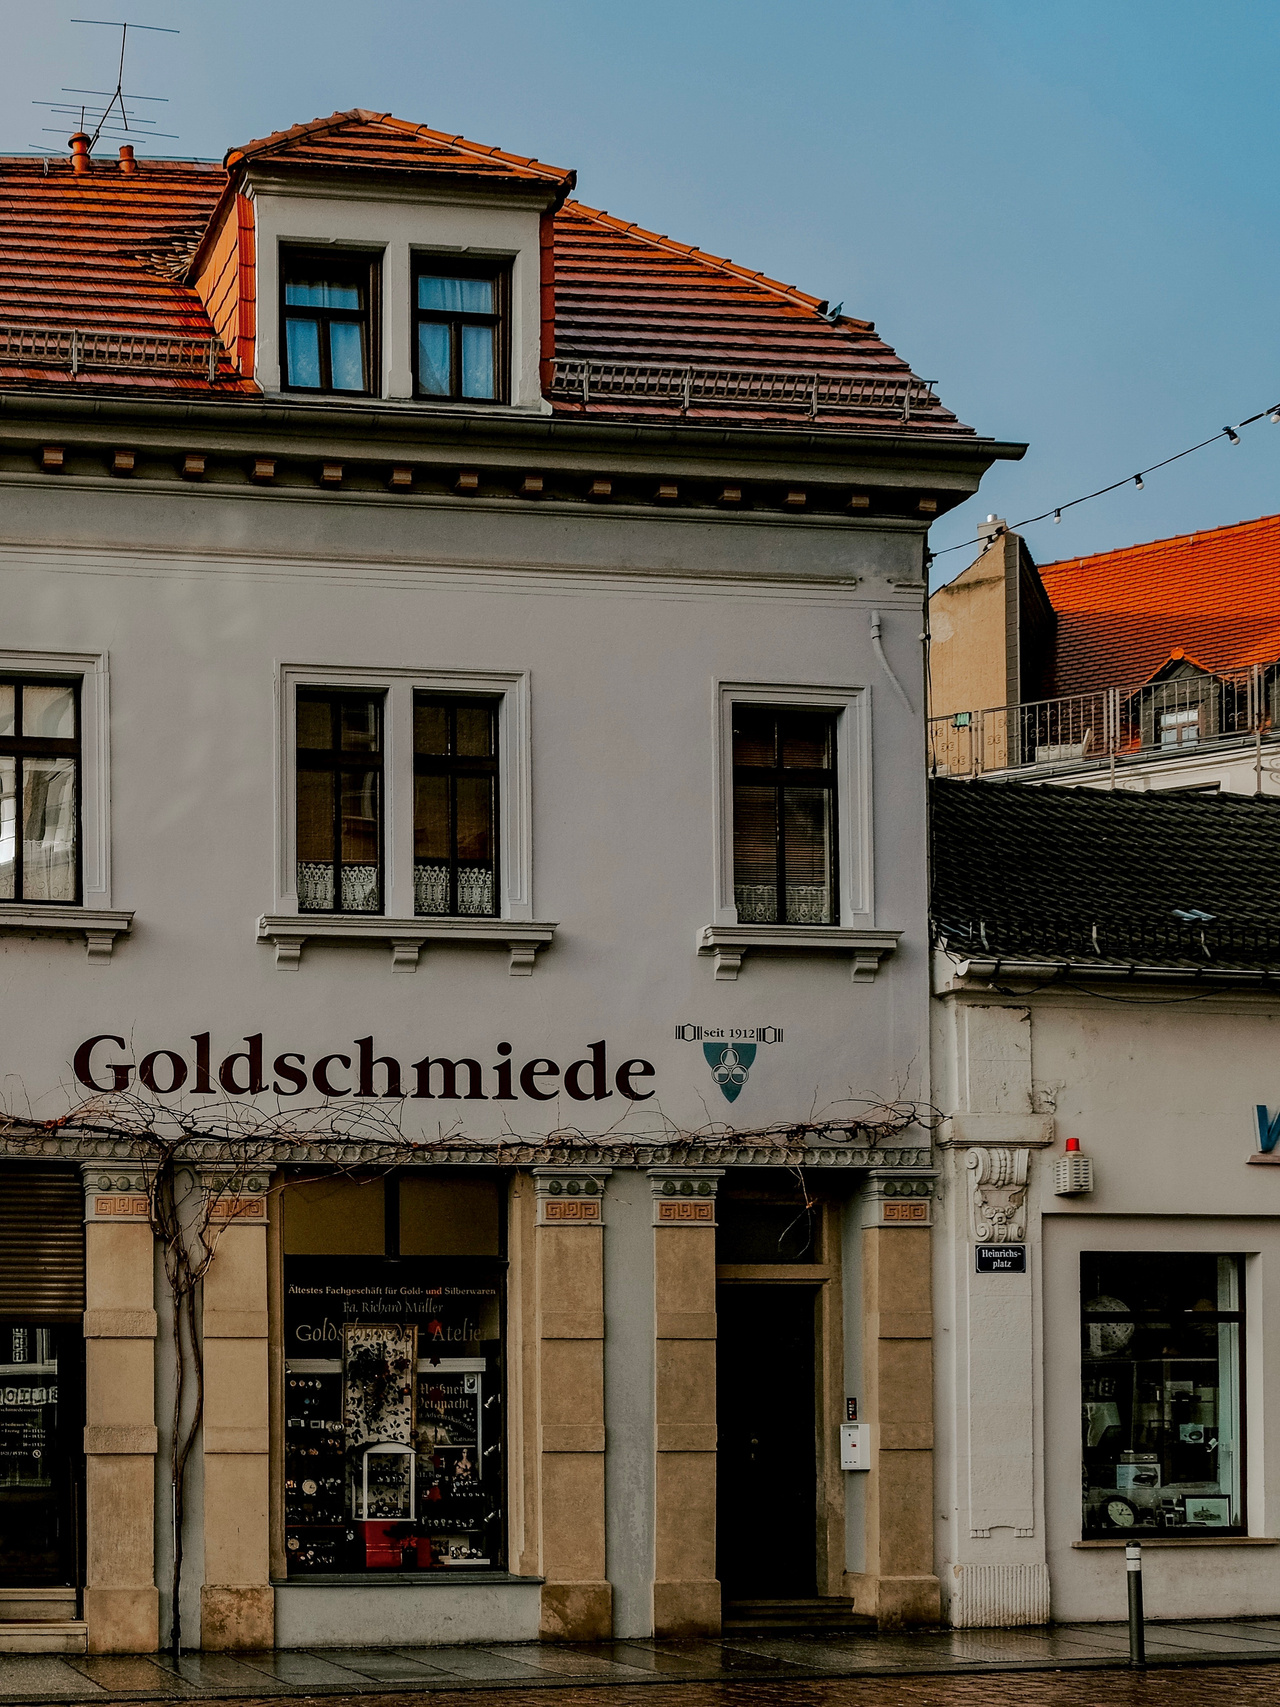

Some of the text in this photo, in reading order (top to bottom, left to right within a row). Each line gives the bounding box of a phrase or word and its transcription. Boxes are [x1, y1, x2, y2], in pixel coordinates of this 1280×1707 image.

[704, 1028, 755, 1040] seit 1912
[72, 1031, 656, 1102] Goldschmiede
[981, 1249, 1022, 1258] Heinrichs-
[992, 1258, 1012, 1270] platz
[288, 1283, 497, 1297] Ältestes Fachgeschäft für Gold- und Silberwaren
[361, 1296, 403, 1315] Richard
[405, 1296, 444, 1313] Müller
